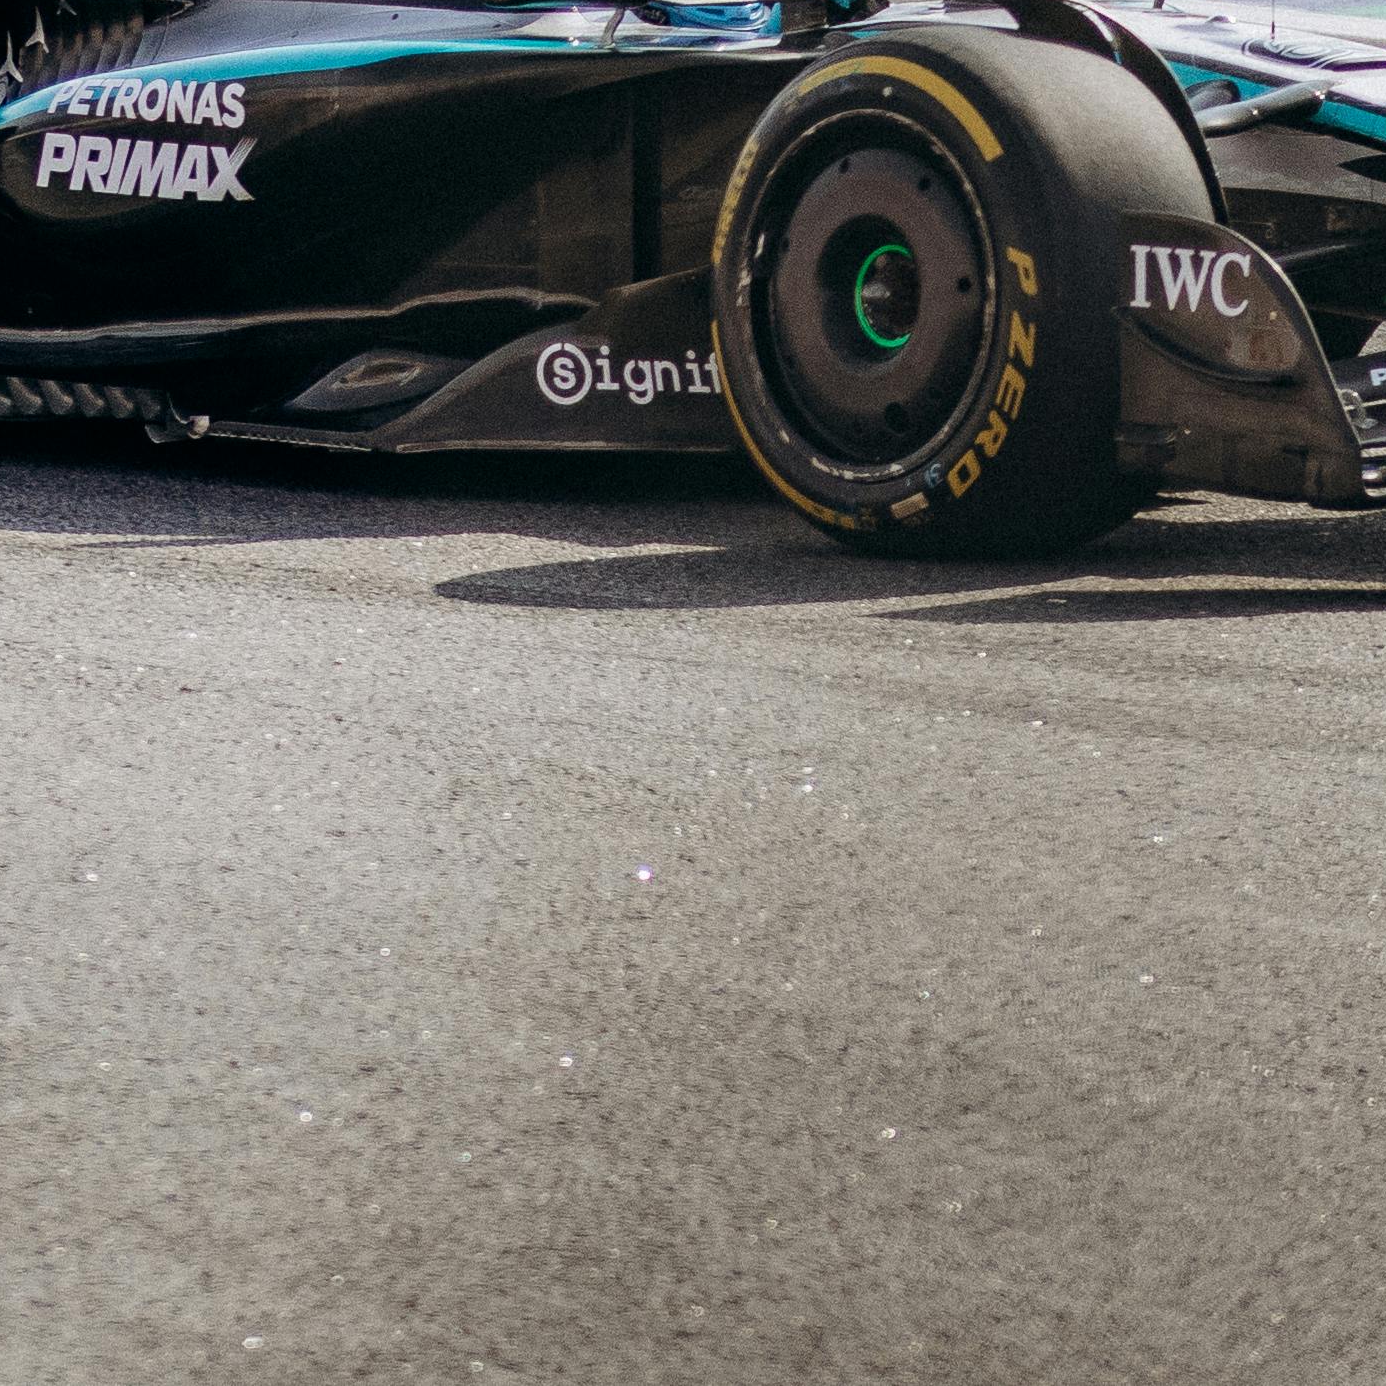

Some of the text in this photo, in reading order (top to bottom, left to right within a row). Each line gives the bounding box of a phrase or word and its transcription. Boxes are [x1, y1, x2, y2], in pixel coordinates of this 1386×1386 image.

[47, 77, 246, 129] PETRONAS
[36, 132, 258, 202] PRIMAX
[1130, 244, 1252, 317] IWC
[946, 247, 1038, 499] P ZERO
